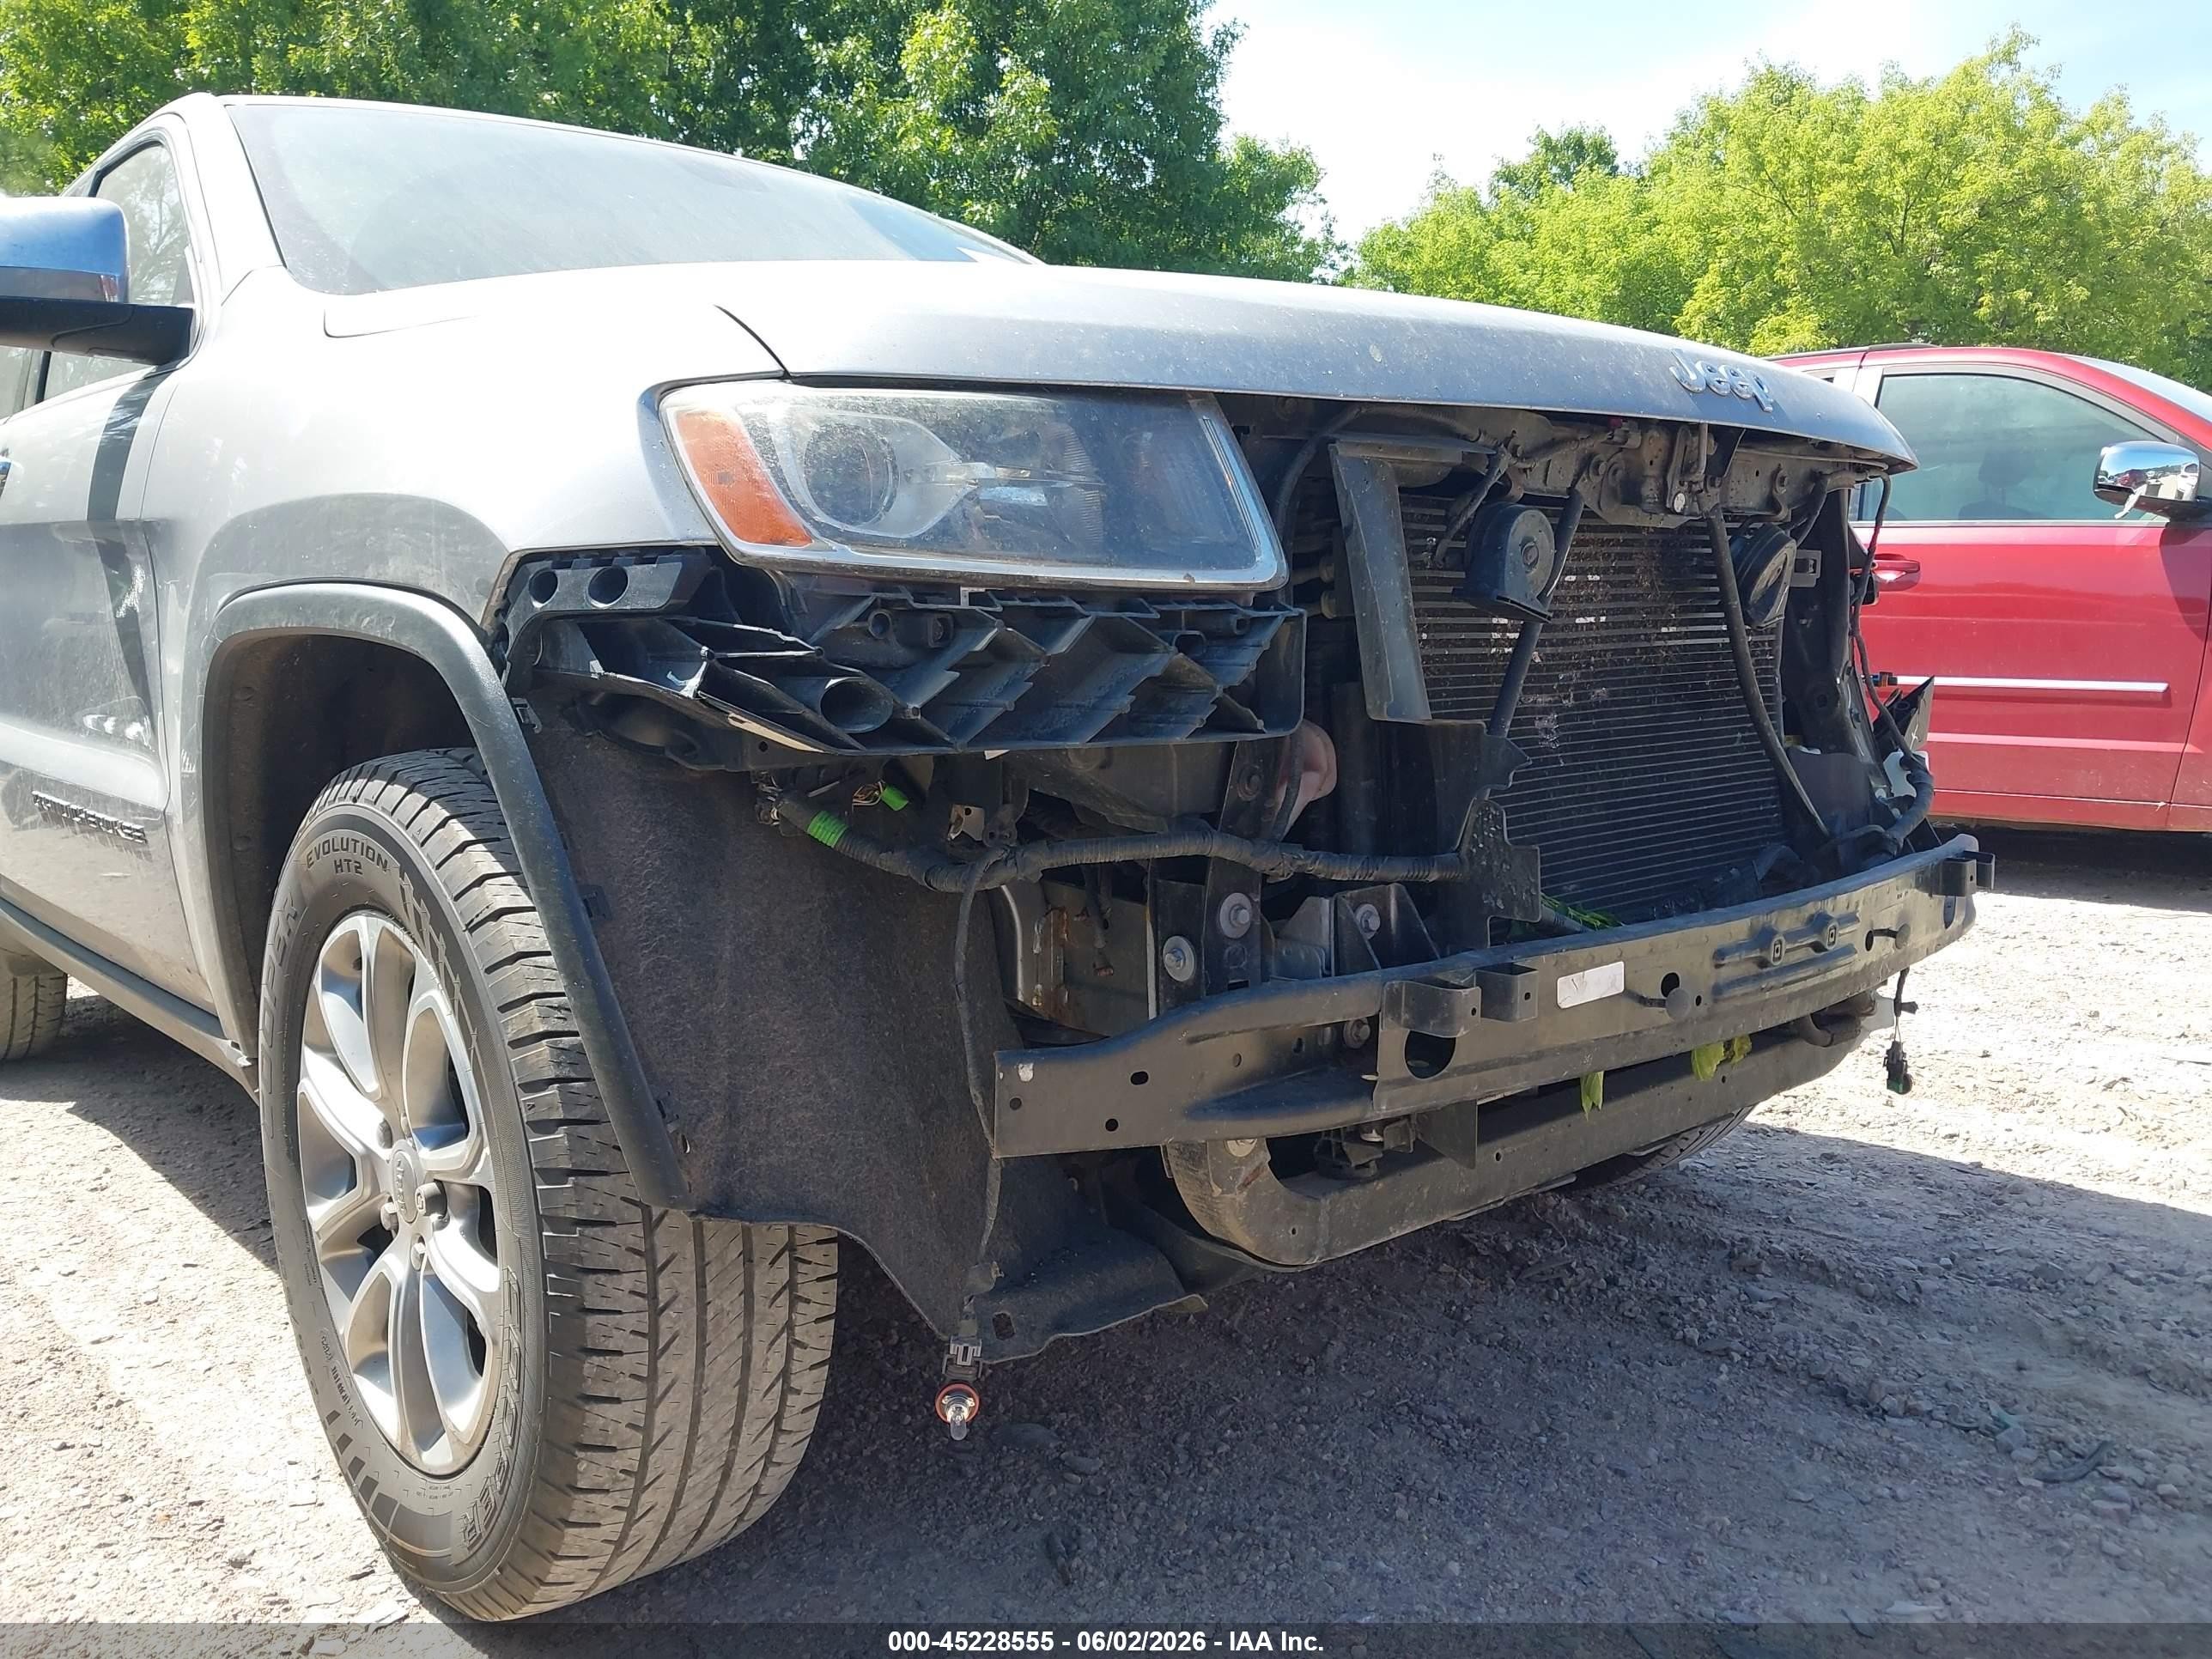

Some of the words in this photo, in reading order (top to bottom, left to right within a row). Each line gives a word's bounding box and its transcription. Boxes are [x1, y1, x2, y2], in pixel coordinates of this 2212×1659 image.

[1669, 349, 1773, 412] Jeep
[306, 836, 388, 873] EVOLUTION
[333, 859, 364, 875] HT2
[459, 1264, 523, 1552] COOPER
